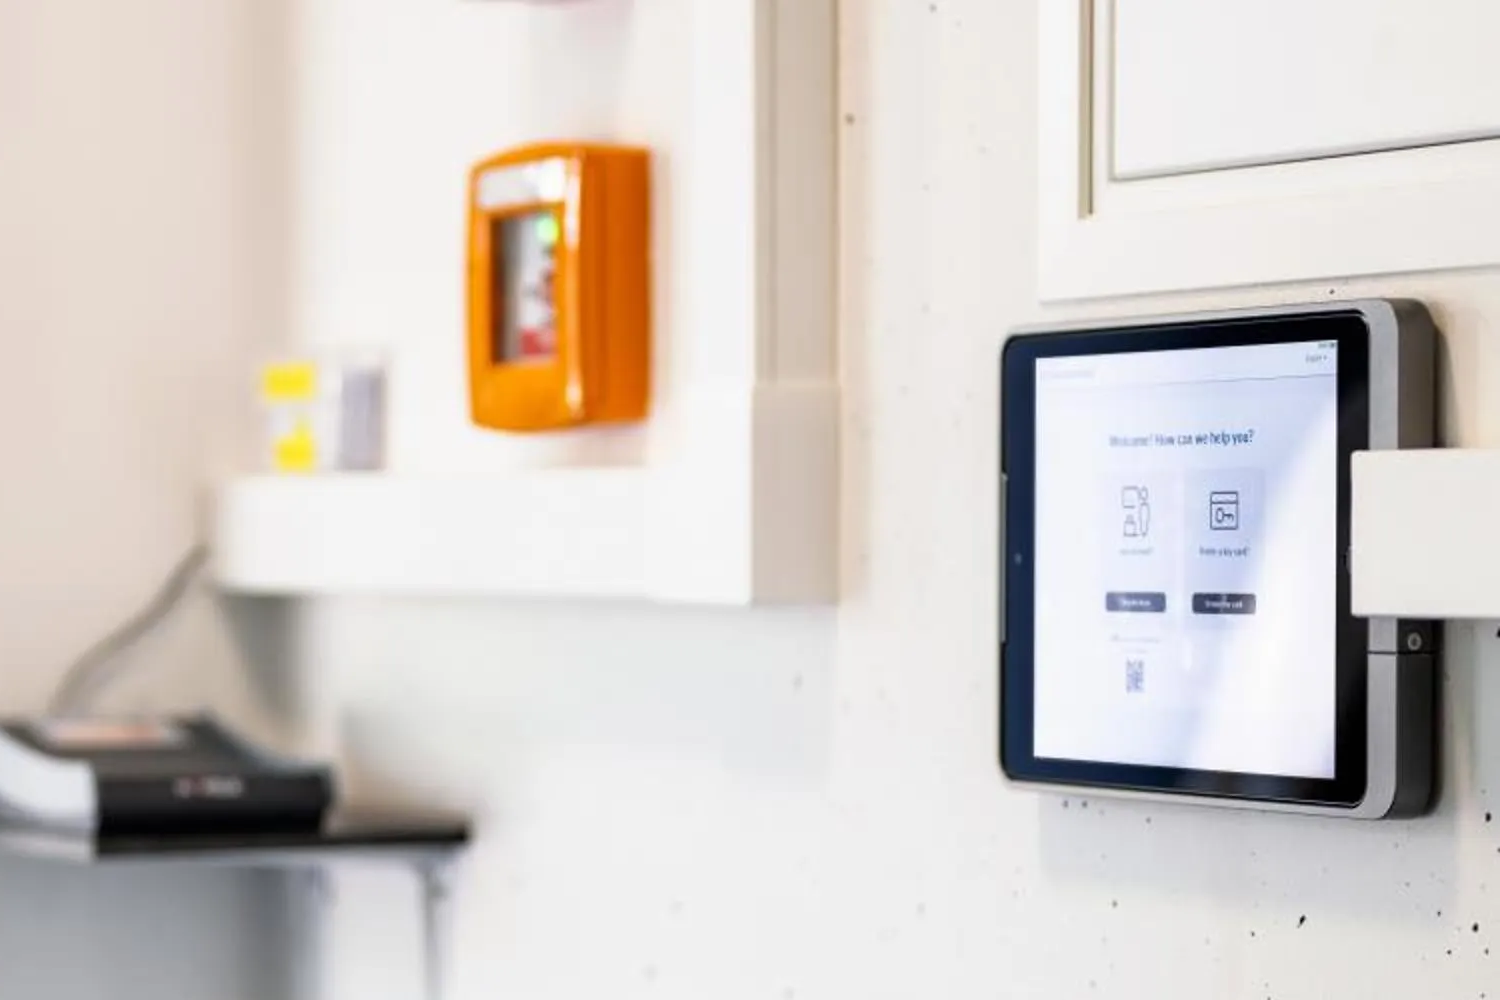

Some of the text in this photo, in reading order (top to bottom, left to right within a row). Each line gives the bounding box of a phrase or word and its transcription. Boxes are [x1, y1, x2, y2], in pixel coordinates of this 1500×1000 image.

[1155, 432, 1175, 446] How
[1177, 433, 1193, 446] can
[1195, 433, 1208, 445] we
[1209, 430, 1230, 446] help
[1231, 428, 1255, 445] you?
